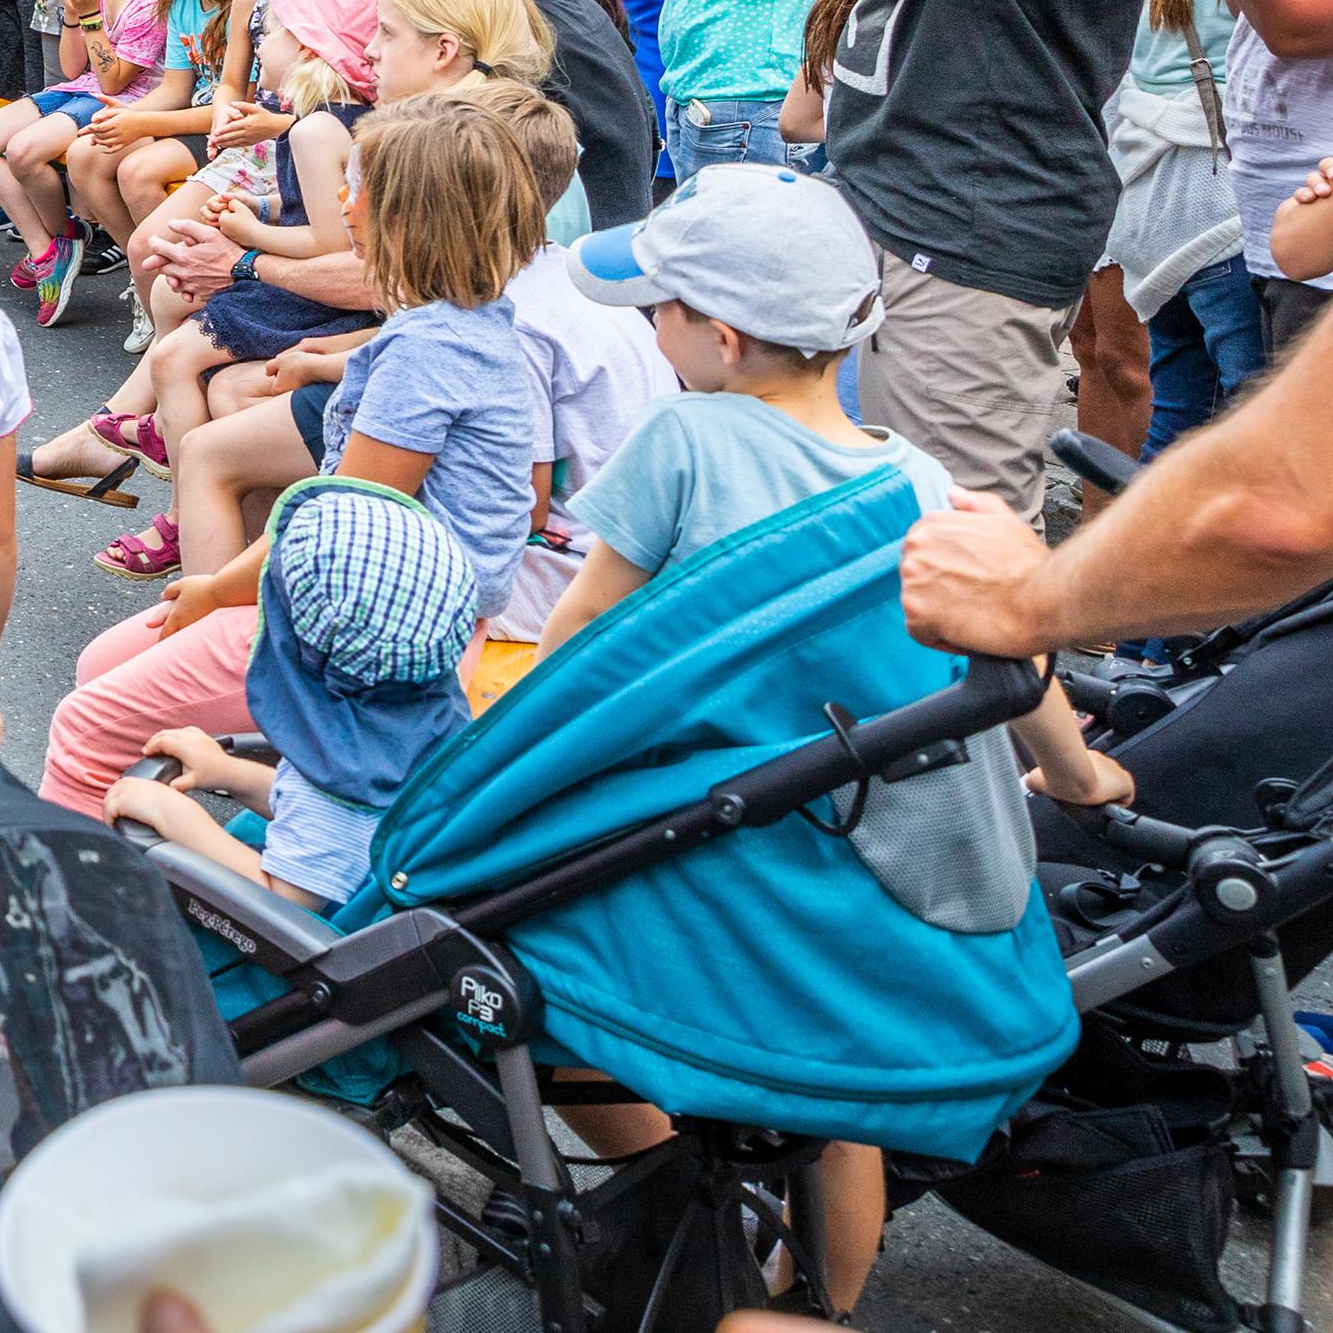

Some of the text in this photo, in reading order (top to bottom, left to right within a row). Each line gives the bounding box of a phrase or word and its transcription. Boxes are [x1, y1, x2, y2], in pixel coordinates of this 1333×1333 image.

[461, 975, 503, 1010] Pliko
[468, 999, 494, 1022] P3
[456, 1011, 507, 1038] compact
